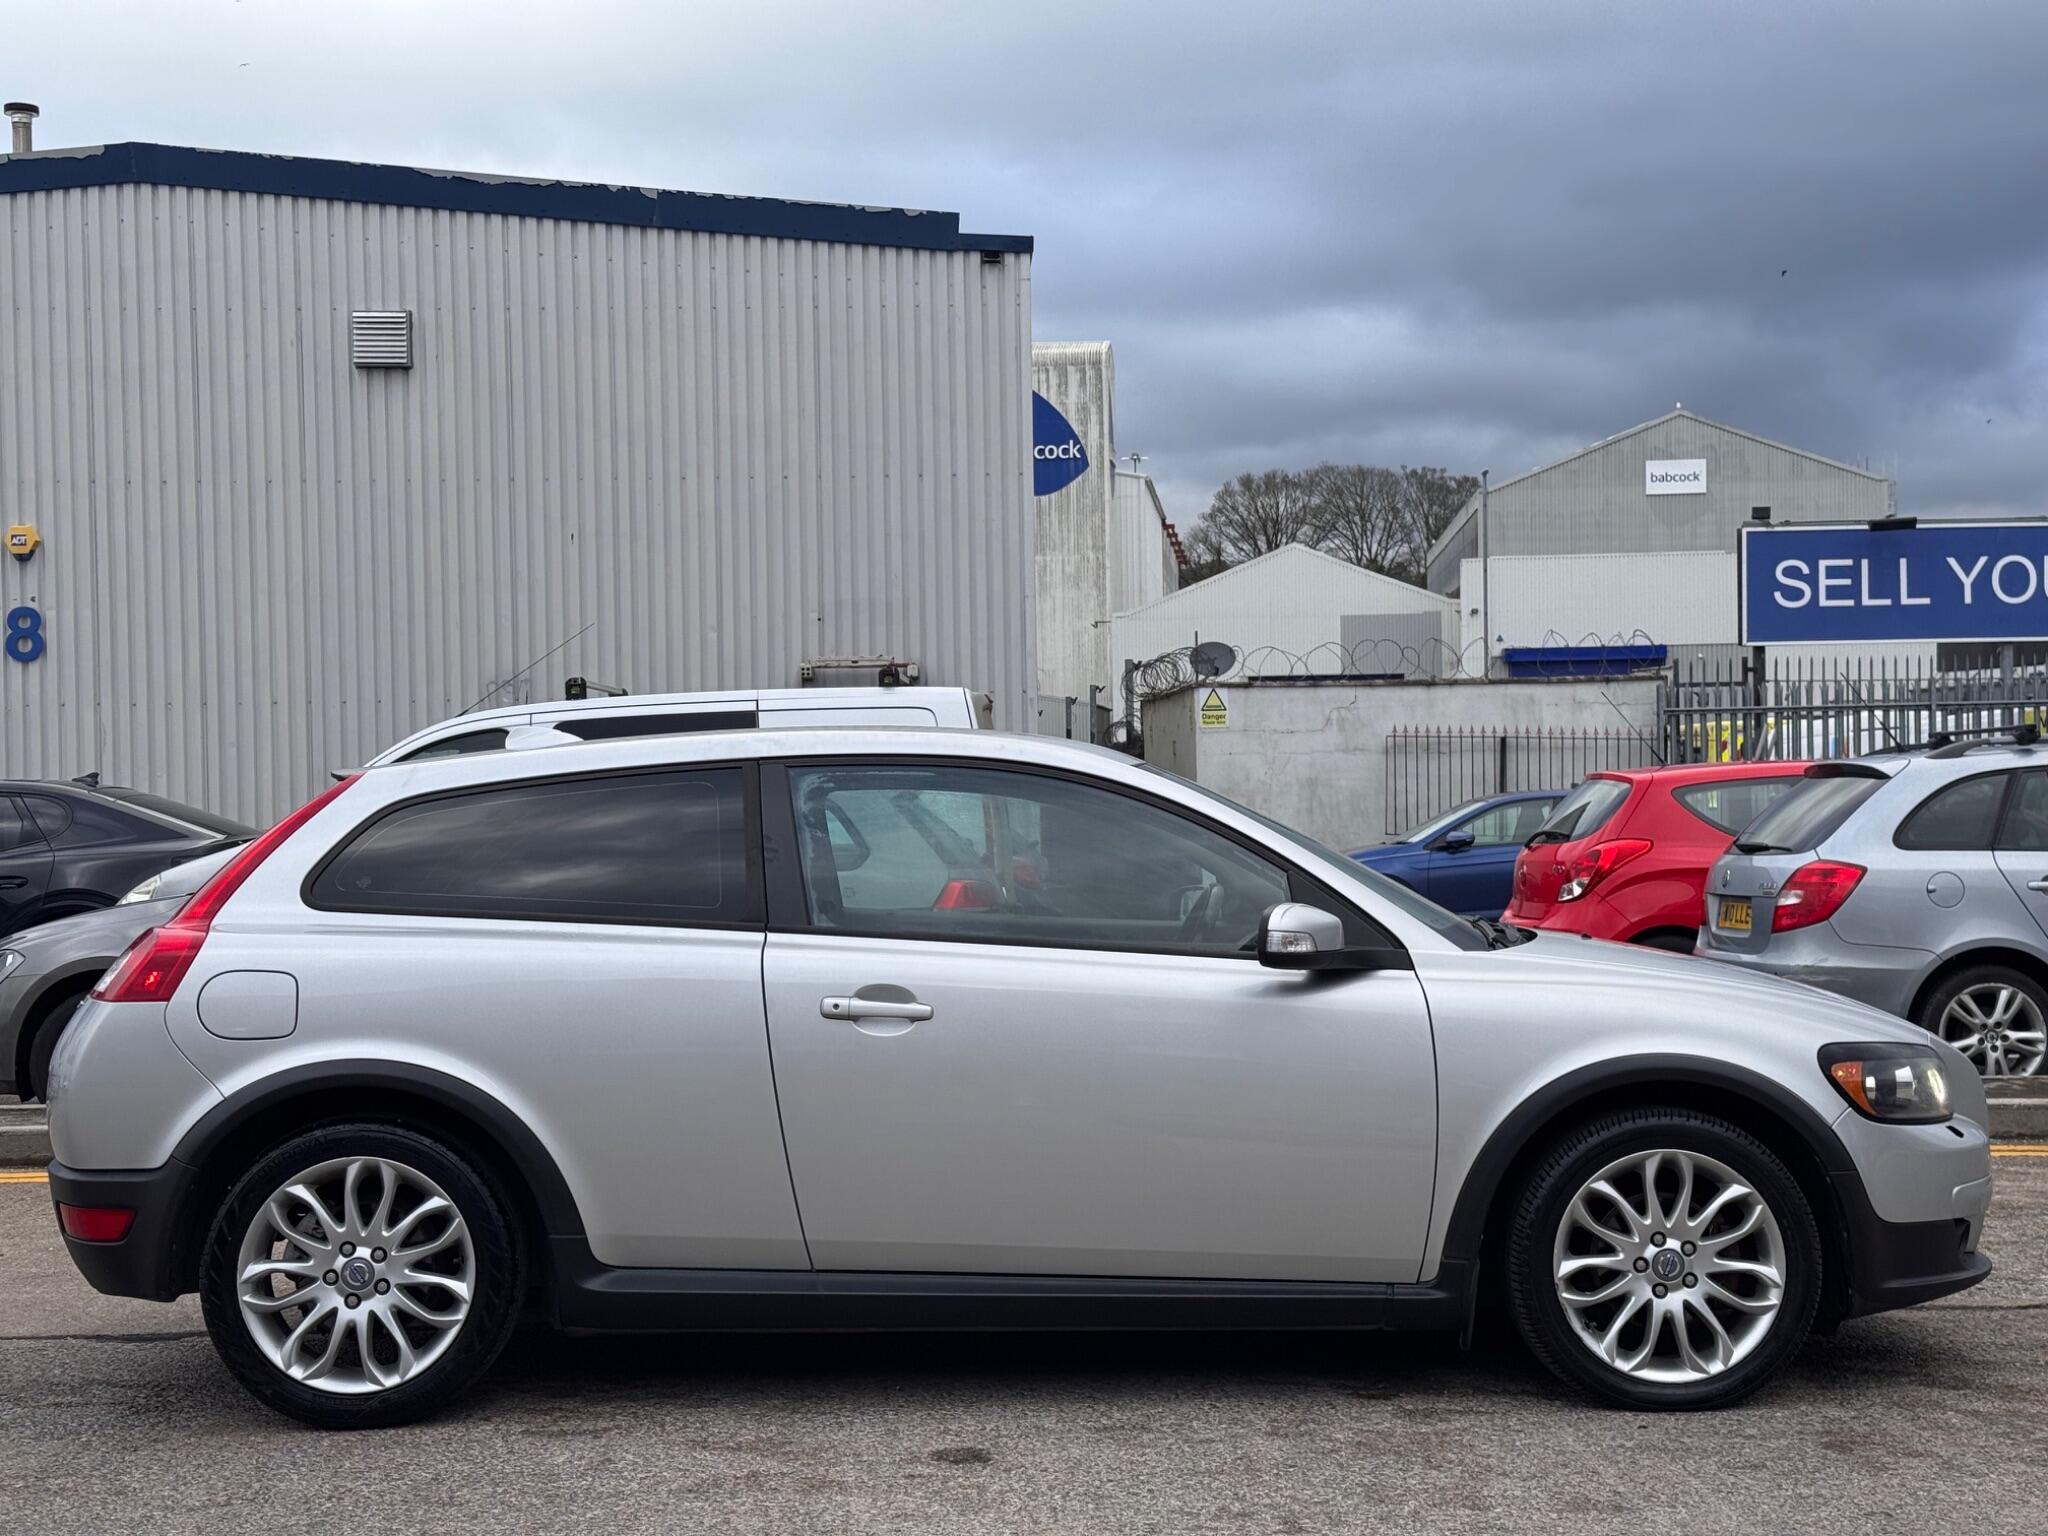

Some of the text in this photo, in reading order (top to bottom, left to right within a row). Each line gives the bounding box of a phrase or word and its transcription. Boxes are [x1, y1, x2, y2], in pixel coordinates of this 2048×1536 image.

[1650, 471, 1700, 483] babcock
[11, 535, 27, 545] ADT
[1773, 554, 2048, 608] SELL YO
[5, 606, 45, 663] 8
[1202, 713, 1226, 721] Danger
